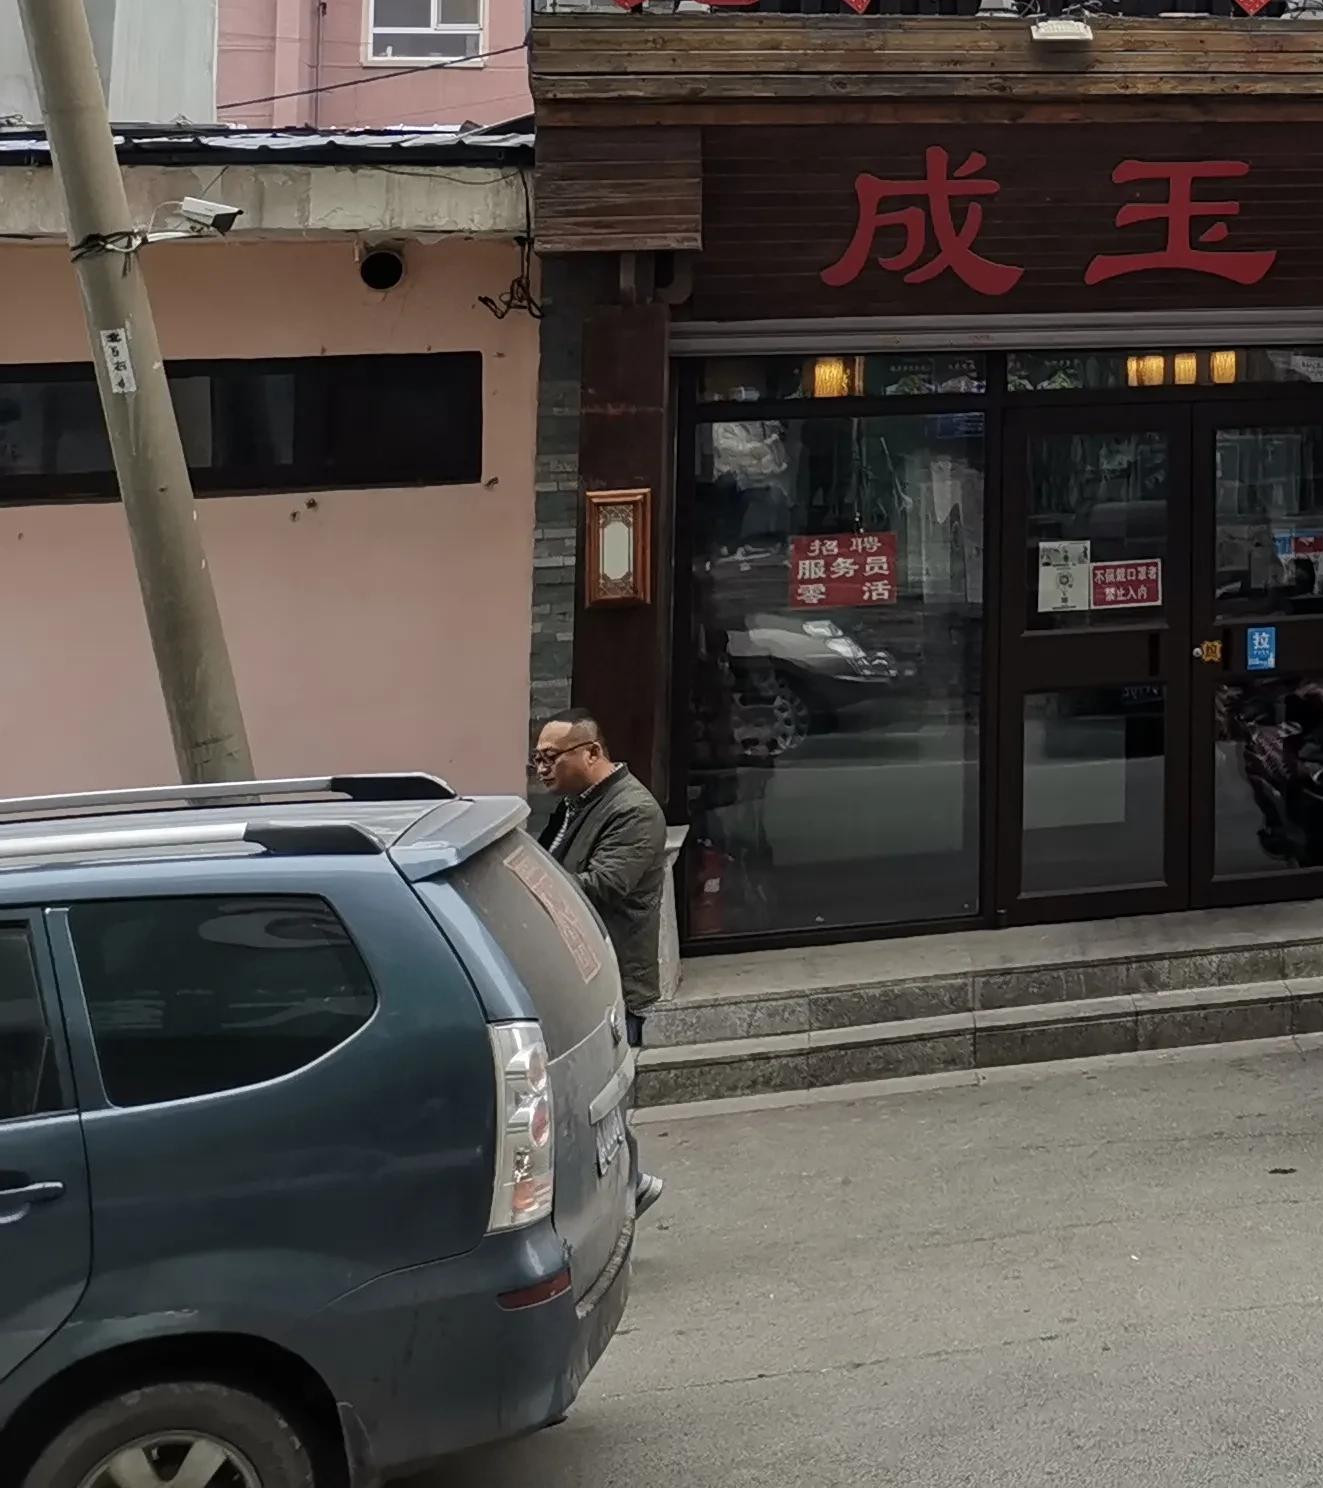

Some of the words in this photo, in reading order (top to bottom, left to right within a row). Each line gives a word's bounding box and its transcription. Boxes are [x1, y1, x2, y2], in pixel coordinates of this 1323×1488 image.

[819, 145, 1277, 295] 成玉
[797, 555, 890, 581] 服务员
